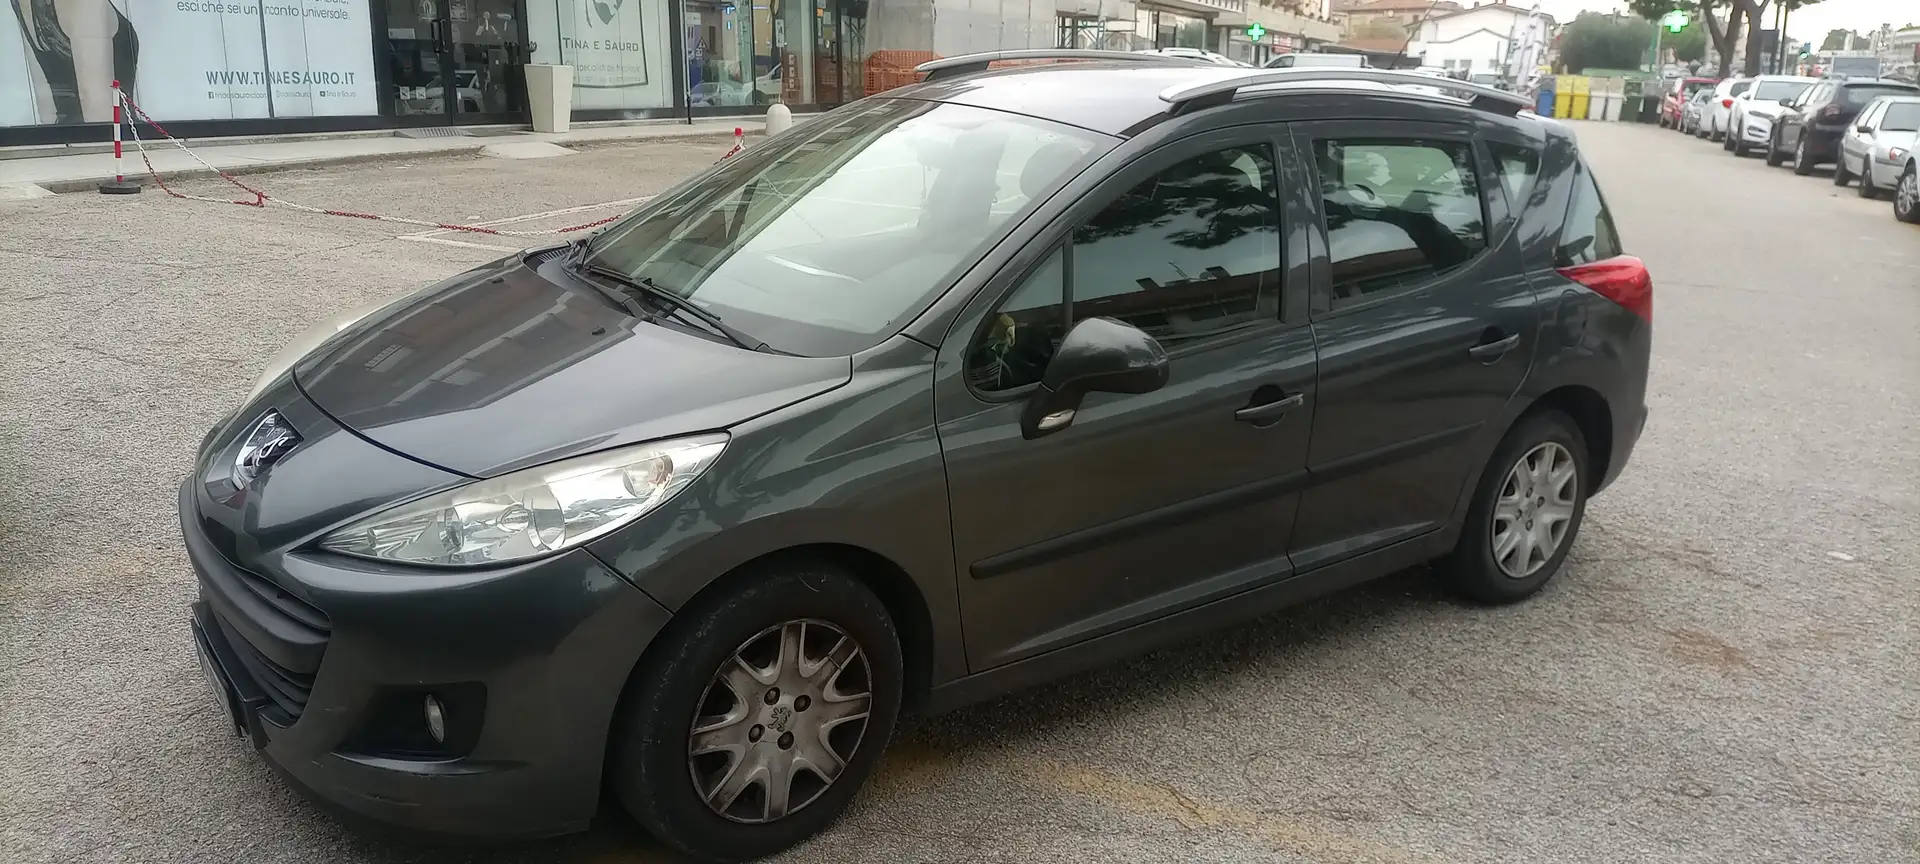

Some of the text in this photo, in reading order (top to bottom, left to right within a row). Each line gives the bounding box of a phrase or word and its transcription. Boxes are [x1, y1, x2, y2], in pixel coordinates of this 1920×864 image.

[176, 0, 200, 12] esci
[201, 1, 224, 13] che
[227, 2, 242, 14] sei
[243, 5, 258, 16] un
[562, 37, 590, 50] TINA
[604, 39, 639, 52] SAURO
[205, 70, 355, 85] WWW.TINAESAURO.IT
